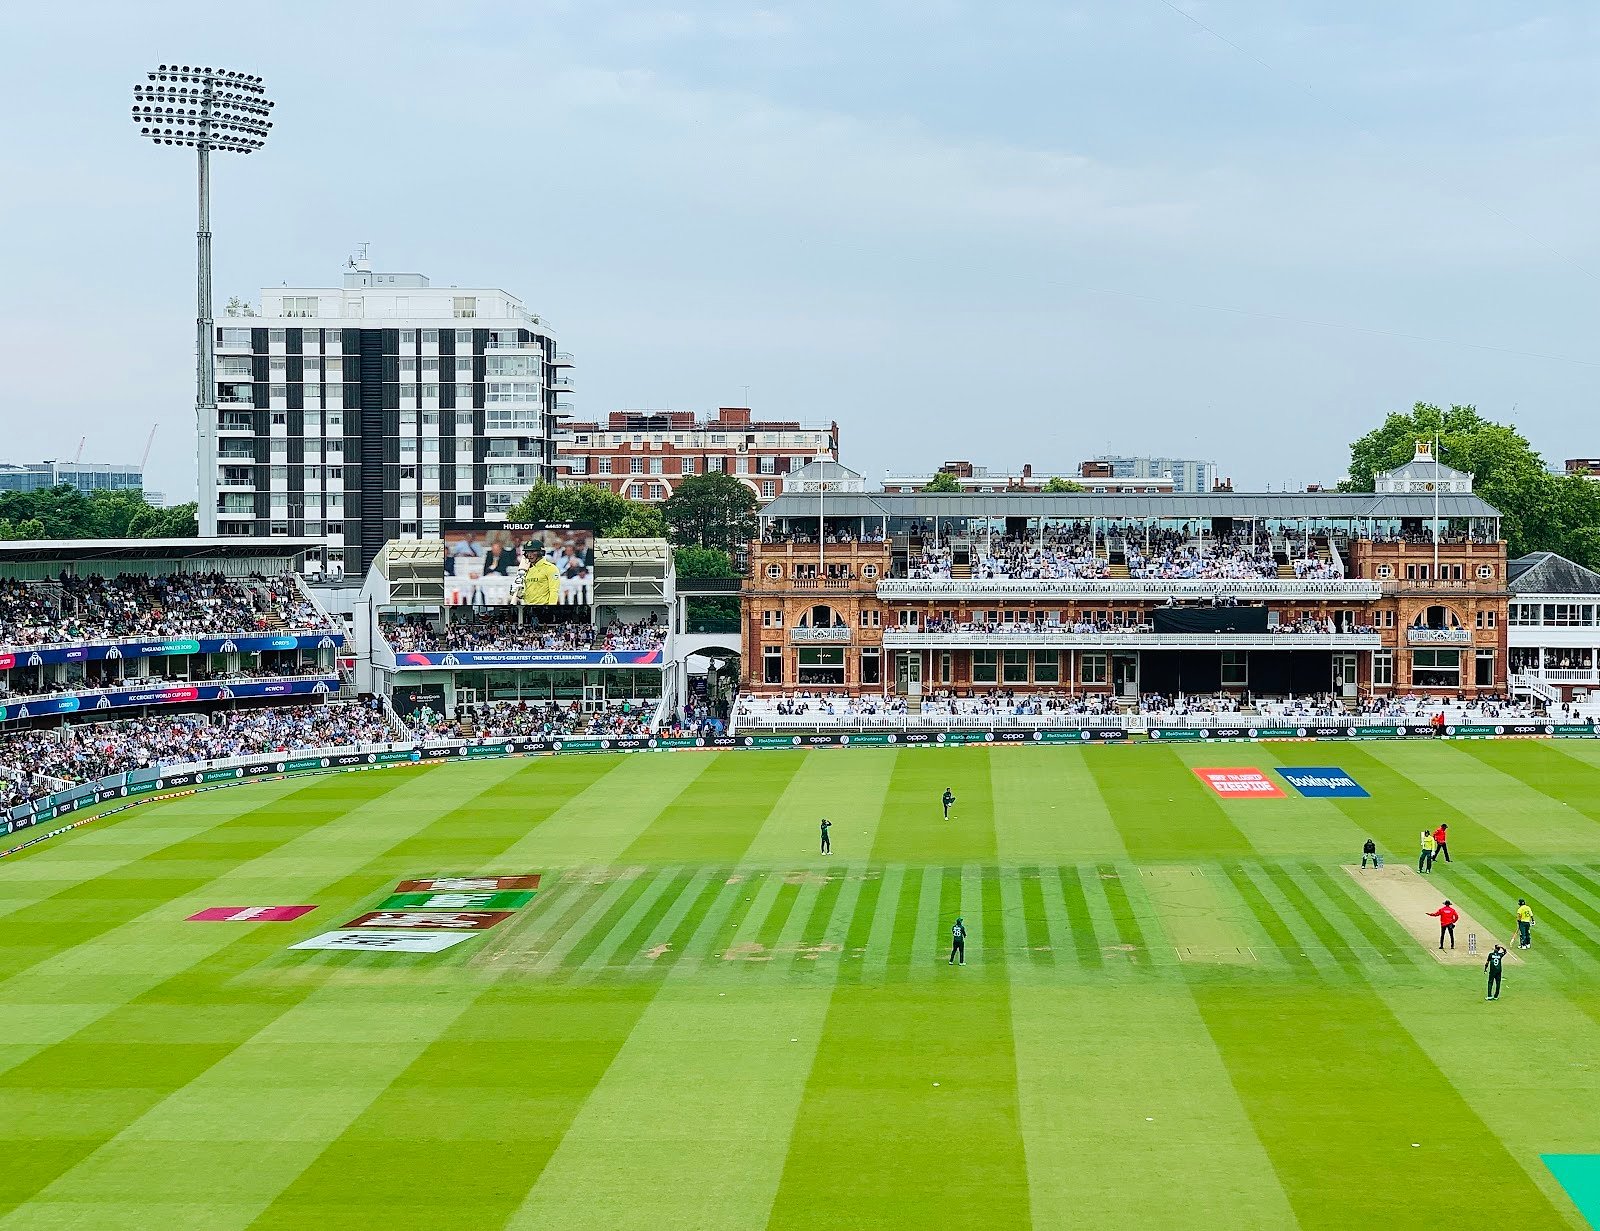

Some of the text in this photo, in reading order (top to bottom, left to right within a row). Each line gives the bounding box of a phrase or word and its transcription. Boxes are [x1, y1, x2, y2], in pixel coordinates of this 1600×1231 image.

[250, 766, 268, 774] oppo
[170, 777, 188, 786] oppo
[1286, 775, 1356, 790] Booking.com
[102, 790, 114, 798] oppo
